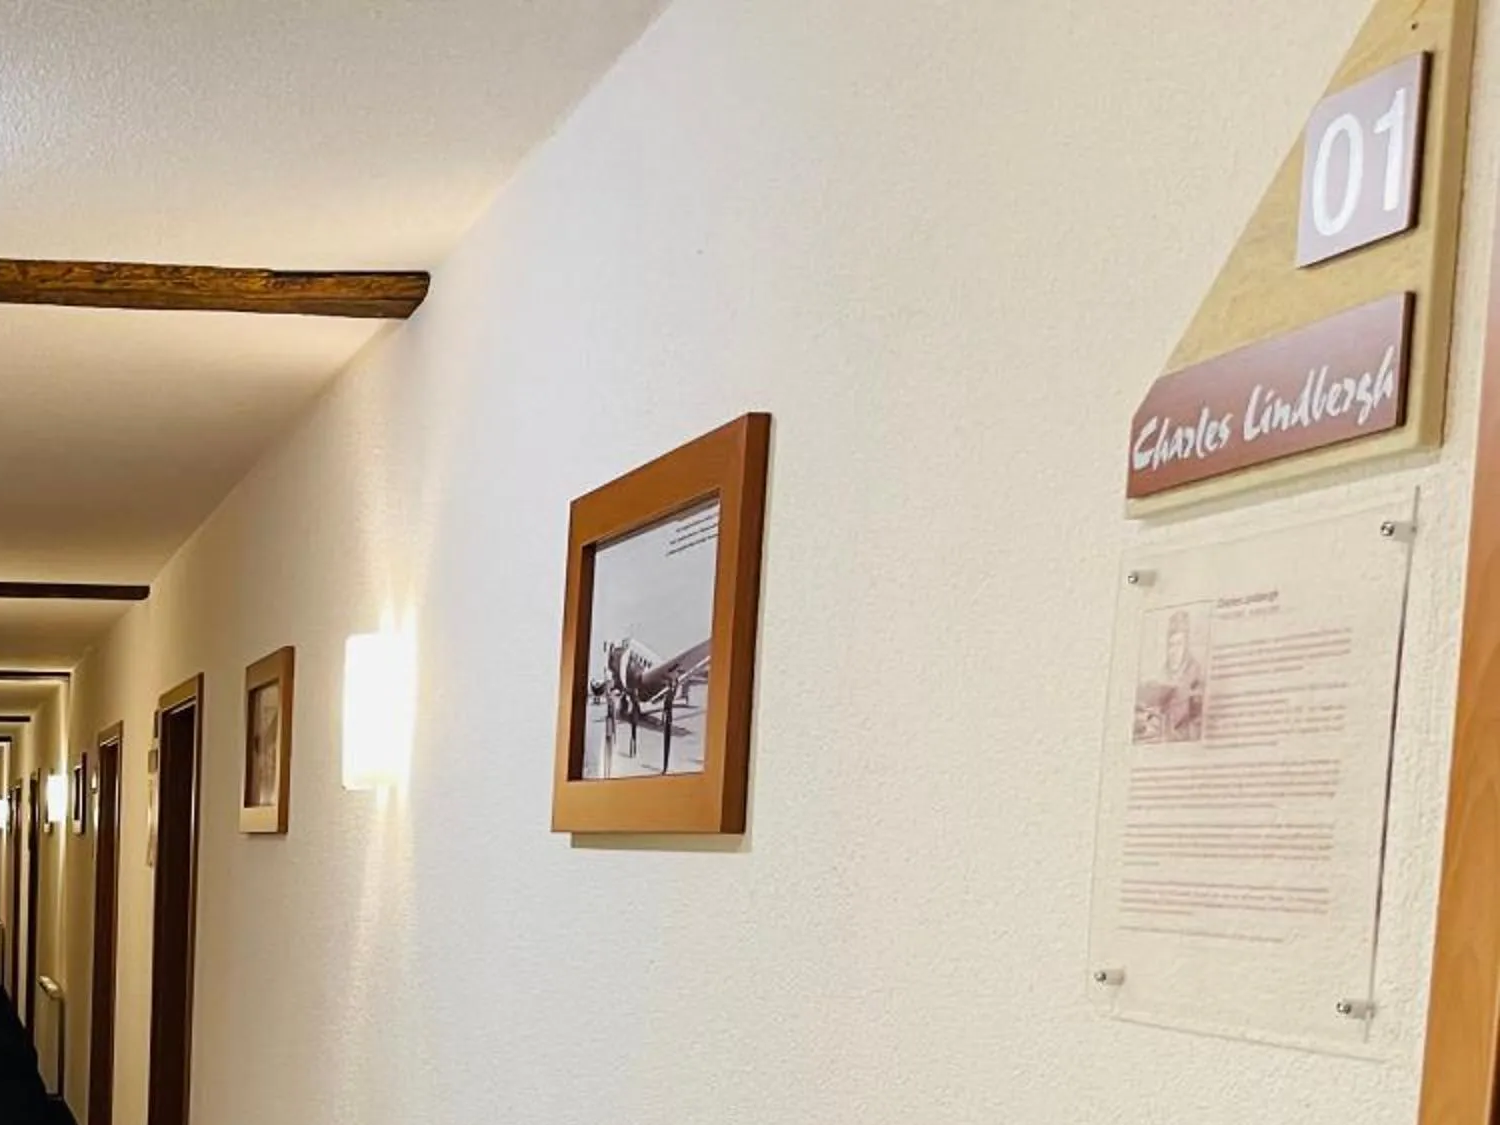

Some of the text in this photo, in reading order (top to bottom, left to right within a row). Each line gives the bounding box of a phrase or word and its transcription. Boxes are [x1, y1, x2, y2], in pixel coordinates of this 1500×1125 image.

[1311, 86, 1408, 237] 01
[1131, 346, 1396, 471] Charles Lindbergh
